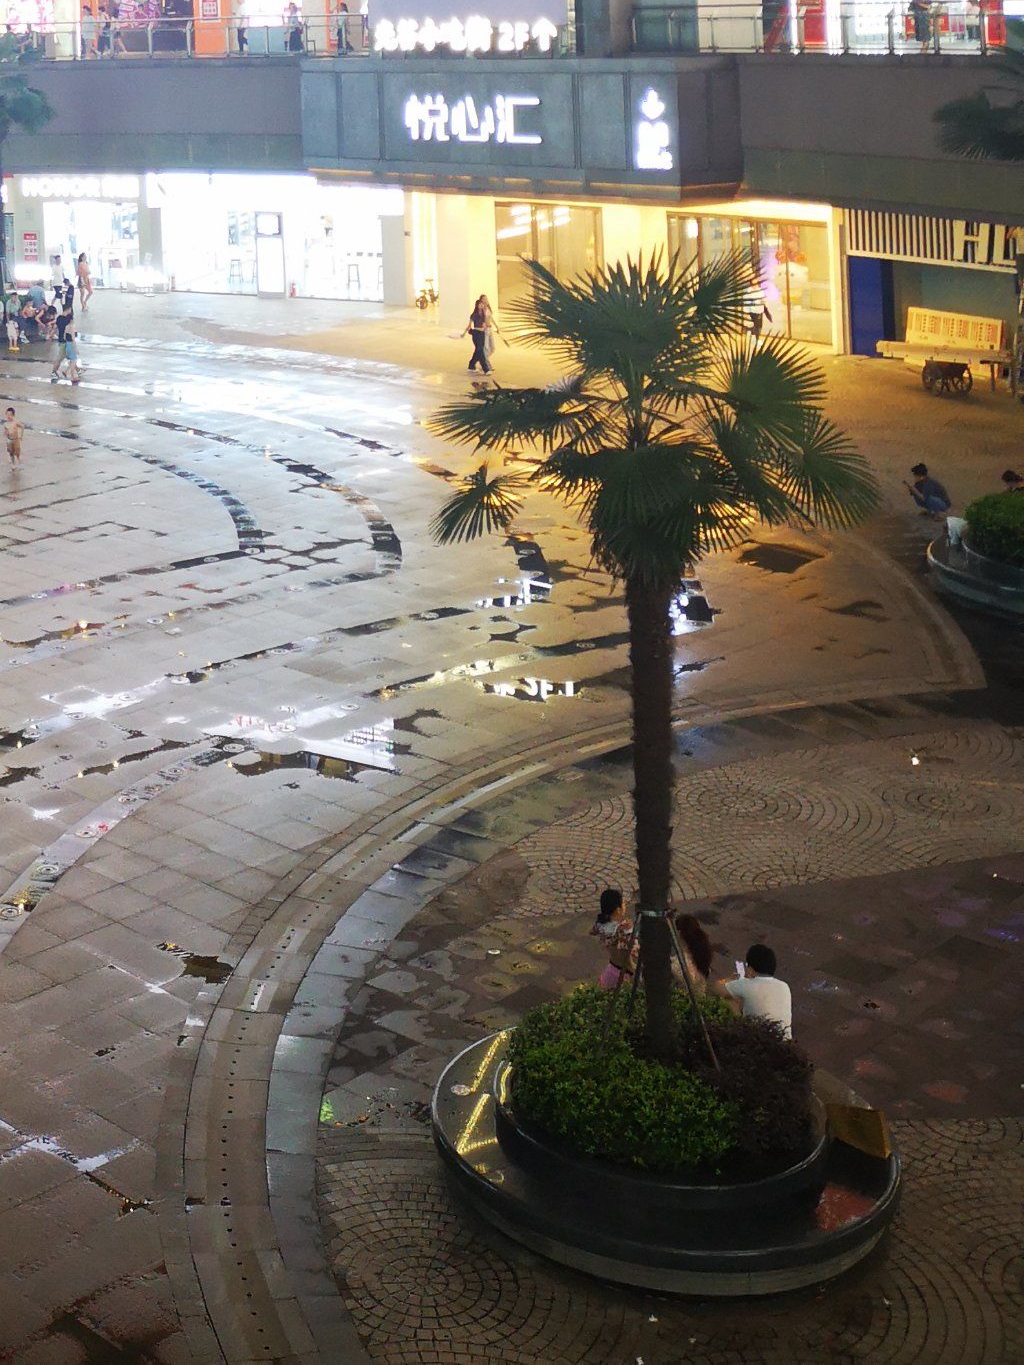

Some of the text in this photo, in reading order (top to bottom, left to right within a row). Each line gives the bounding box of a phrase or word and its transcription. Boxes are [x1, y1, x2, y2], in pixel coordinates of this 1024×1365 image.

[498, 21, 530, 52] 2F
[404, 93, 543, 144] 悦心汇
